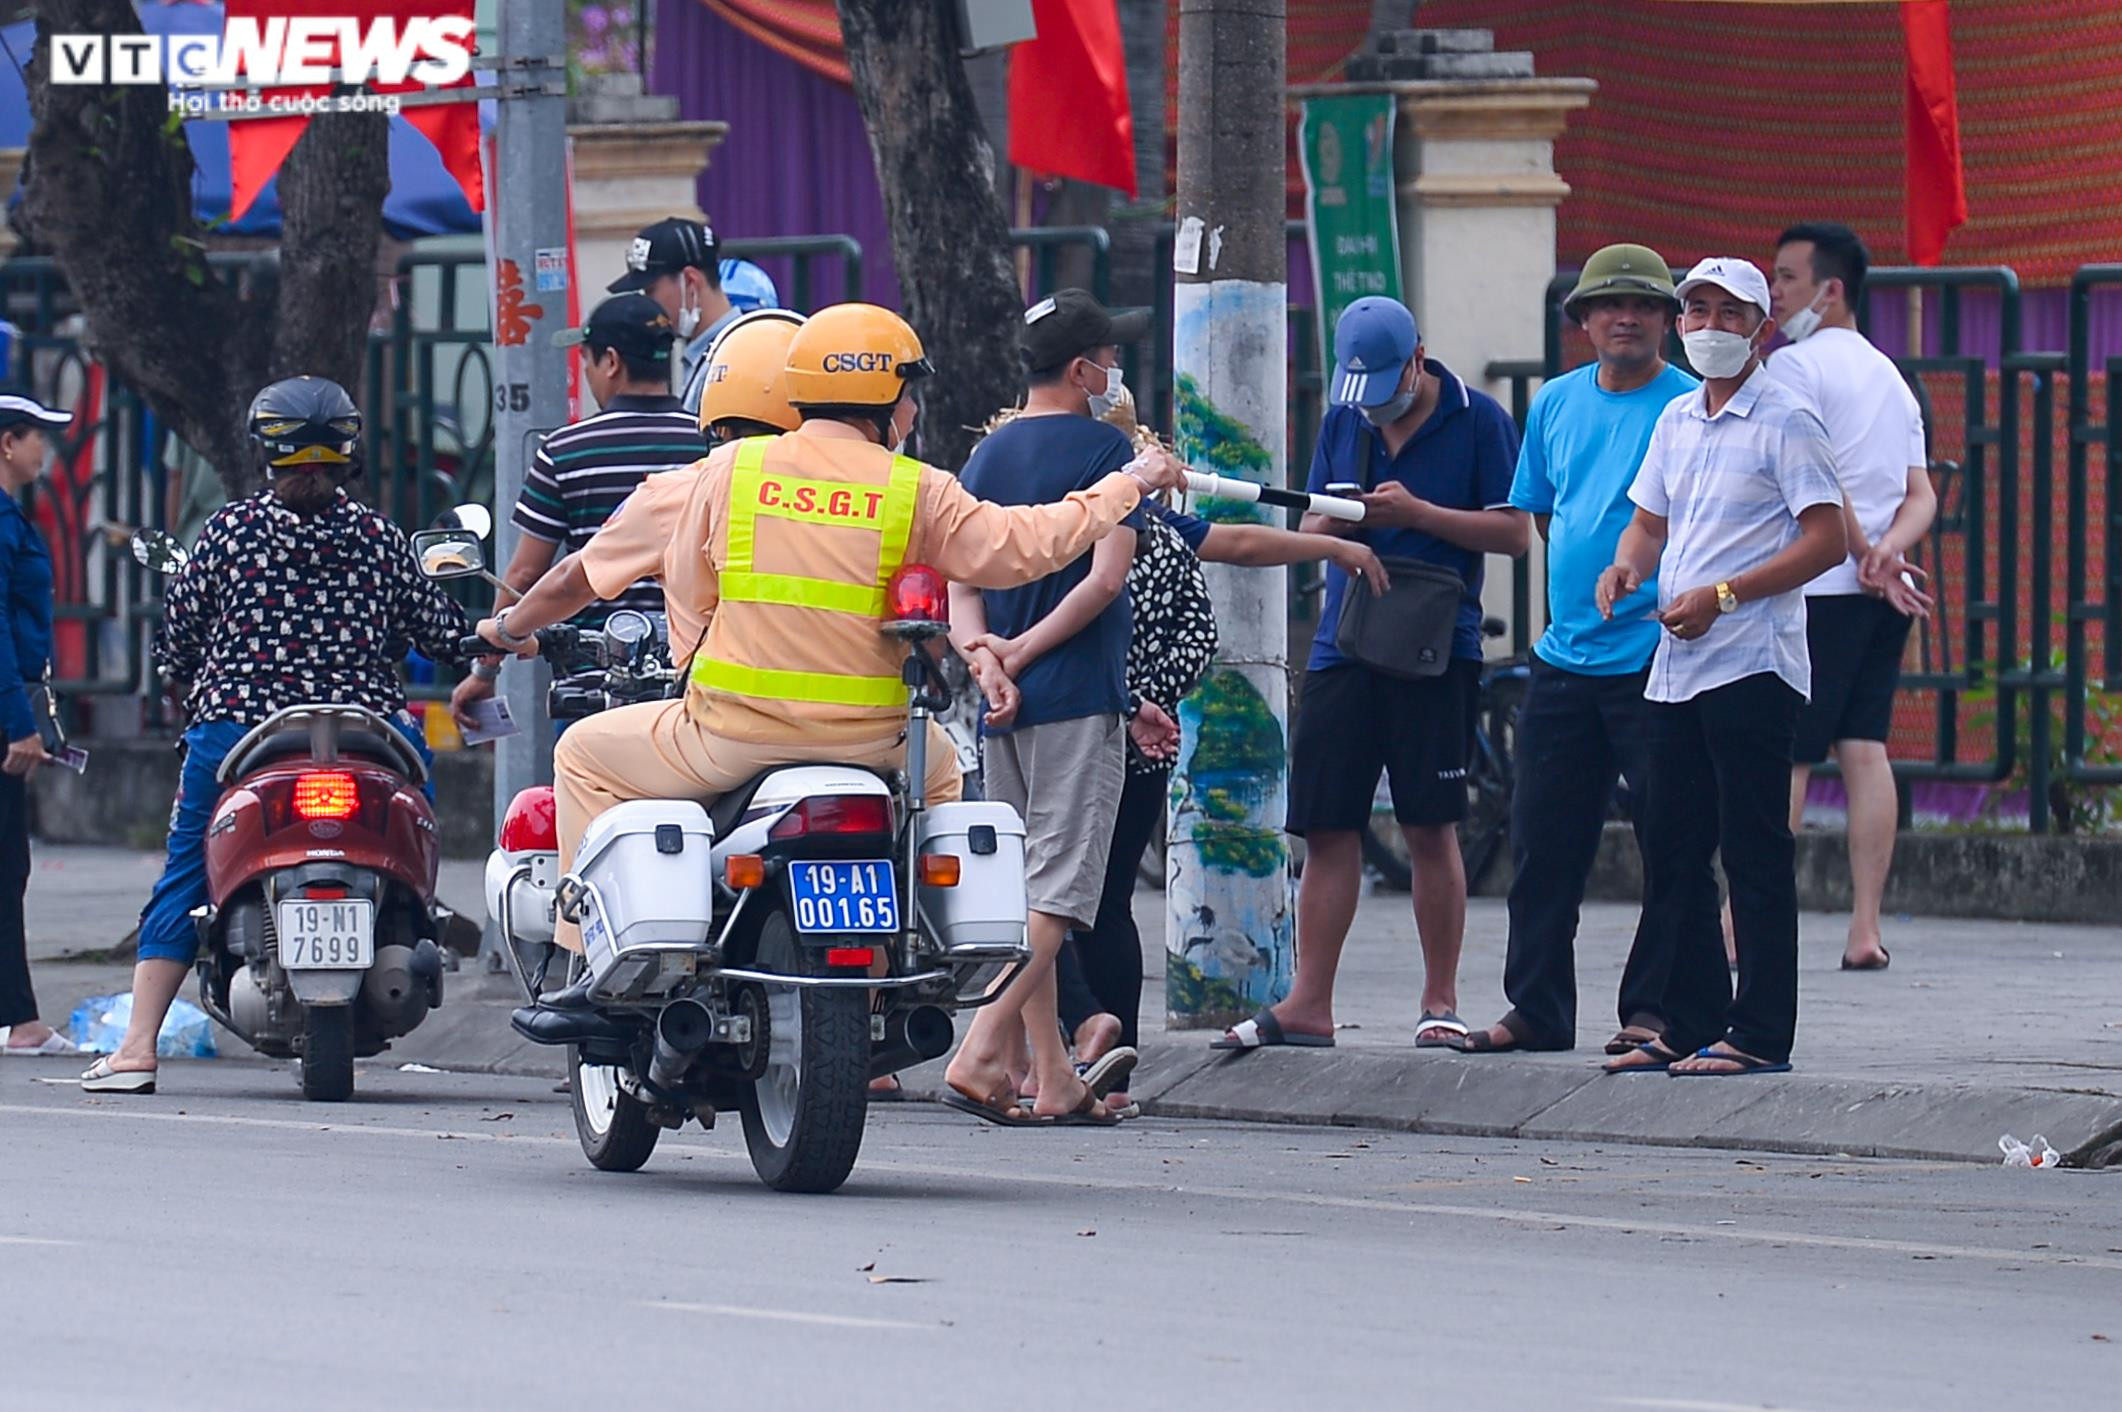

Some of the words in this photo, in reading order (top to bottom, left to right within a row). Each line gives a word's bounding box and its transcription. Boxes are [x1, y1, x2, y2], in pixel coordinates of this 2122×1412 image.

[823, 353, 893, 373] CSGT
[758, 481, 884, 519] C.S.G.T
[807, 864, 879, 894] 19-A1
[296, 906, 358, 932] 19-N1
[800, 896, 894, 928] 001.65
[293, 937, 360, 964] 7699
